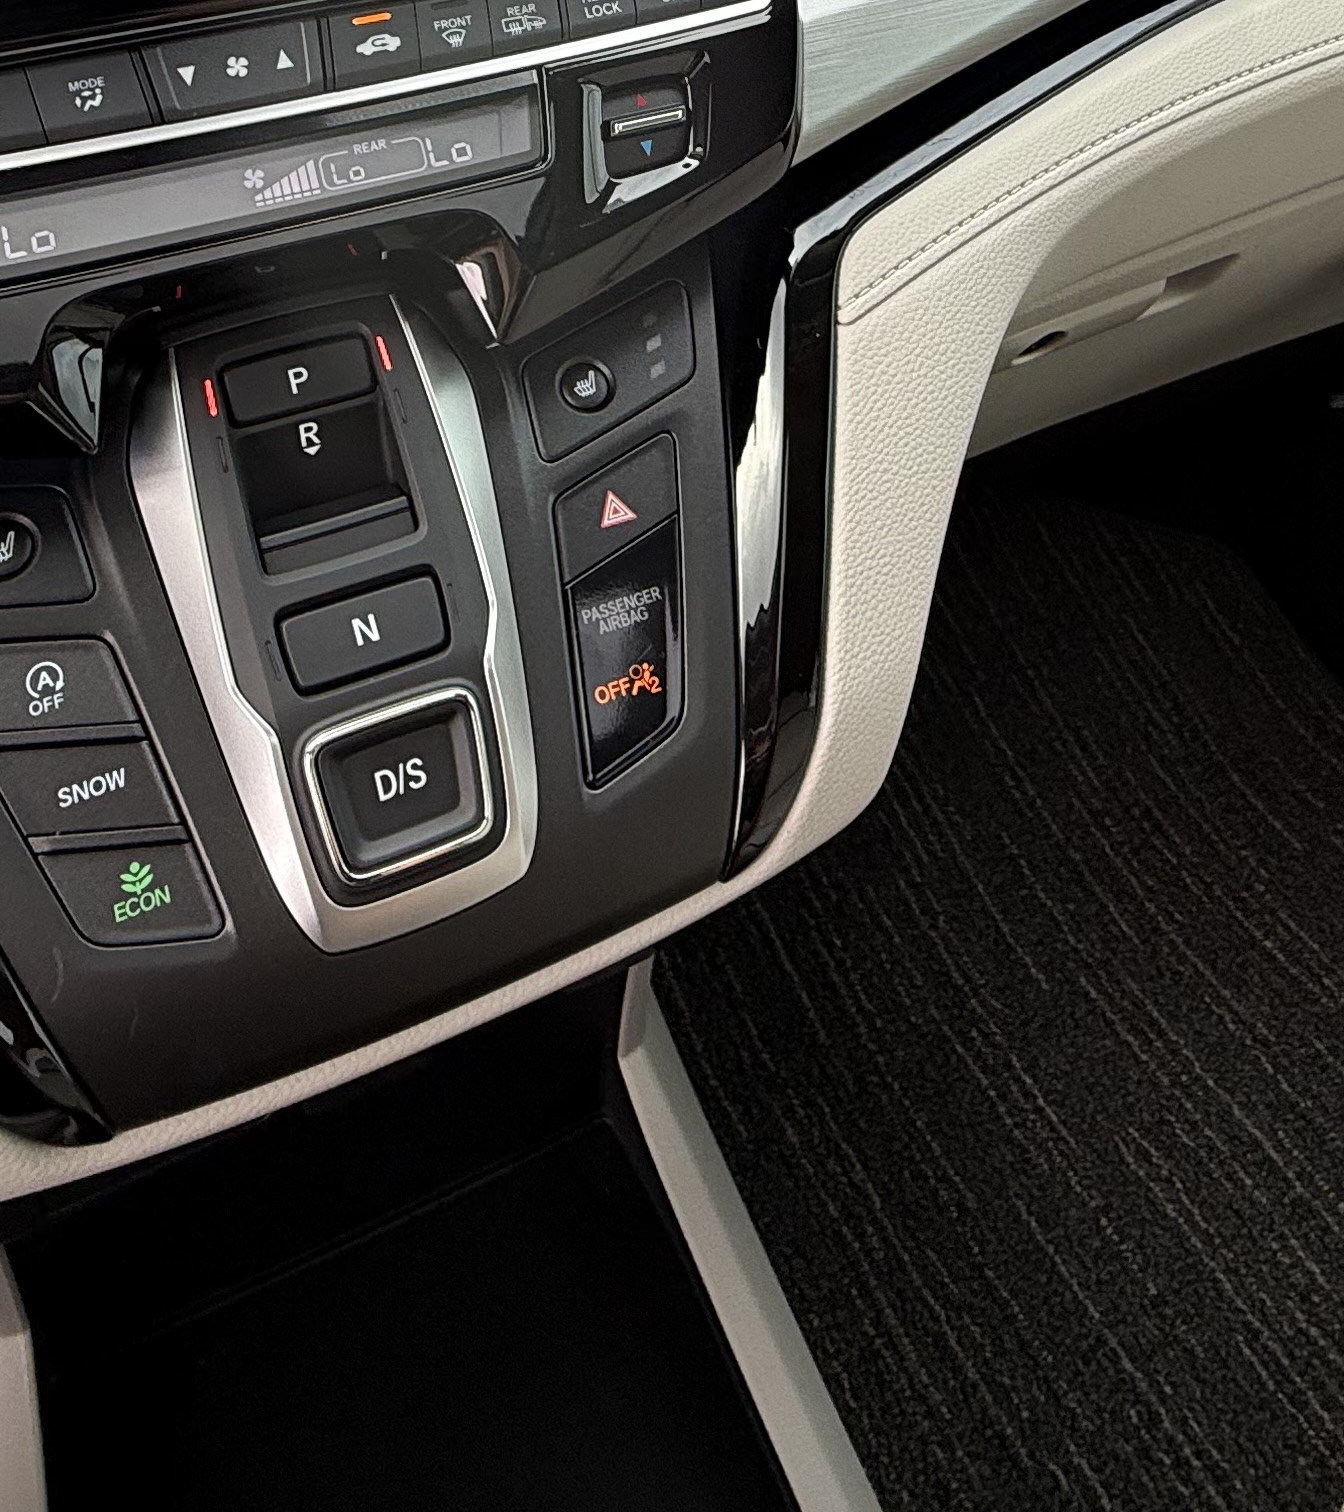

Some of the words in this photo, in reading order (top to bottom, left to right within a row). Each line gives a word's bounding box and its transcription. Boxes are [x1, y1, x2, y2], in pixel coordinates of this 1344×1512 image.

[433, 14, 472, 33] FRONT
[506, 3, 537, 19] REAR
[583, 0, 622, 19] LOCK
[67, 76, 105, 94] MODE
[353, 138, 387, 156] REAR
[287, 366, 309, 394] P
[298, 421, 321, 447] R
[580, 586, 663, 626] PASSENGER
[351, 613, 381, 647] N
[598, 605, 650, 636] AIRBAG
[28, 692, 64, 716] OFF
[594, 676, 631, 704] OFF
[57, 767, 127, 809] SNOW
[373, 757, 429, 801] D/S
[112, 884, 173, 924] ECON
